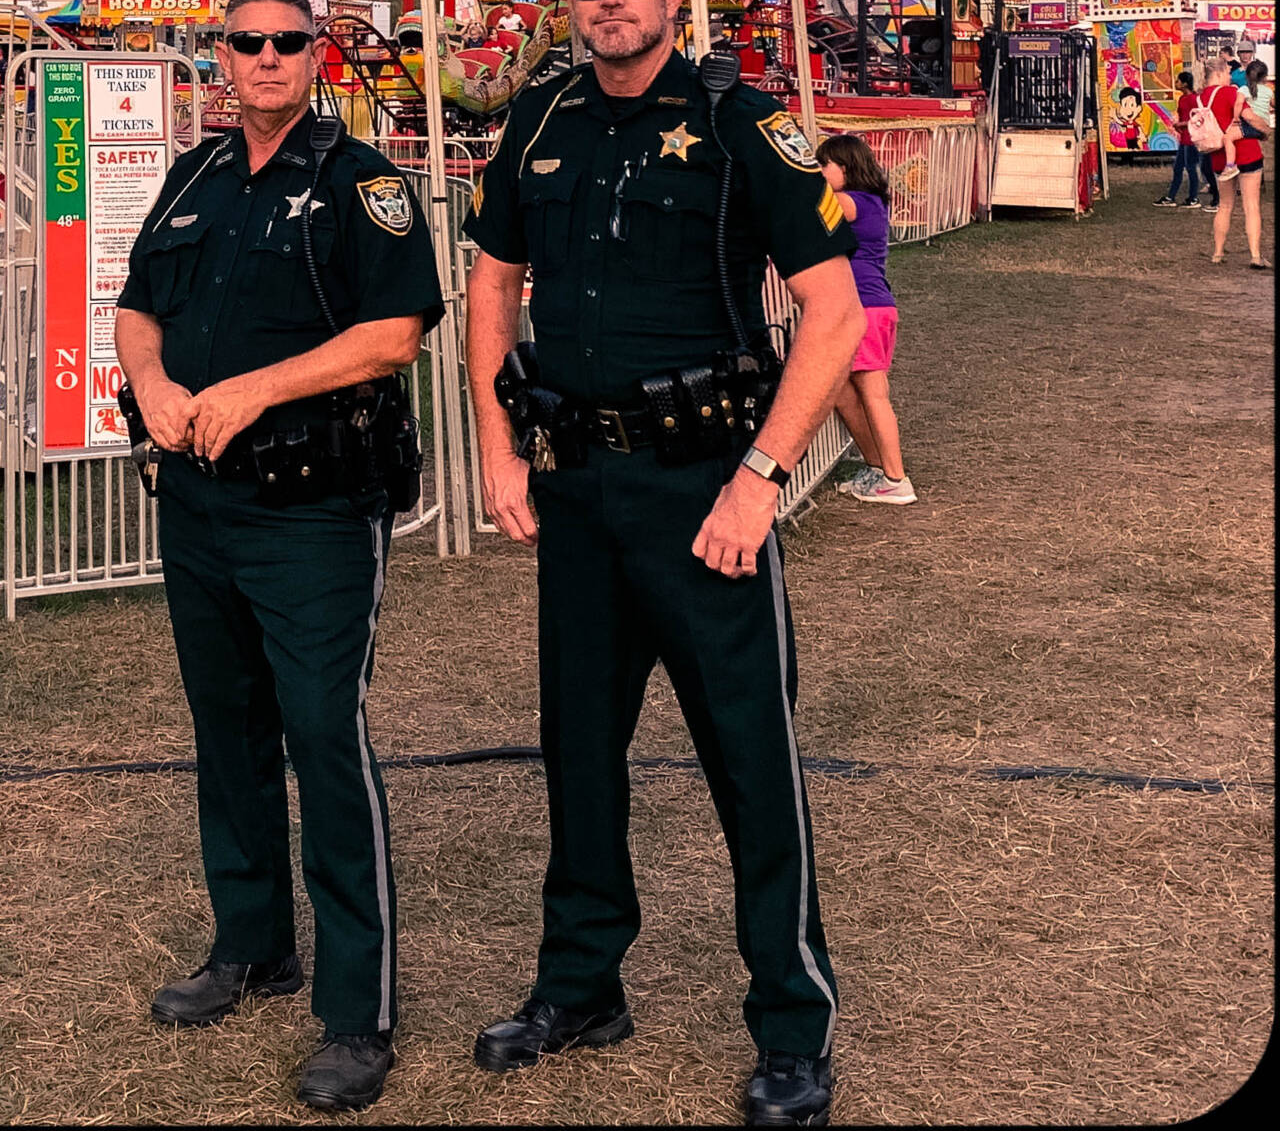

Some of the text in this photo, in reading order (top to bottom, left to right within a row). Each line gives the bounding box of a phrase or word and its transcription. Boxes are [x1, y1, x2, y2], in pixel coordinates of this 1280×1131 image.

[95, 68, 156, 79] THIS RIDE
[107, 81, 147, 92] TAKES
[119, 97, 132, 112] 4
[102, 119, 154, 130] TICKETS
[51, 117, 81, 193] YES
[96, 150, 158, 165] SAFETY
[56, 214, 80, 227] 48"
[55, 348, 79, 390] NO
